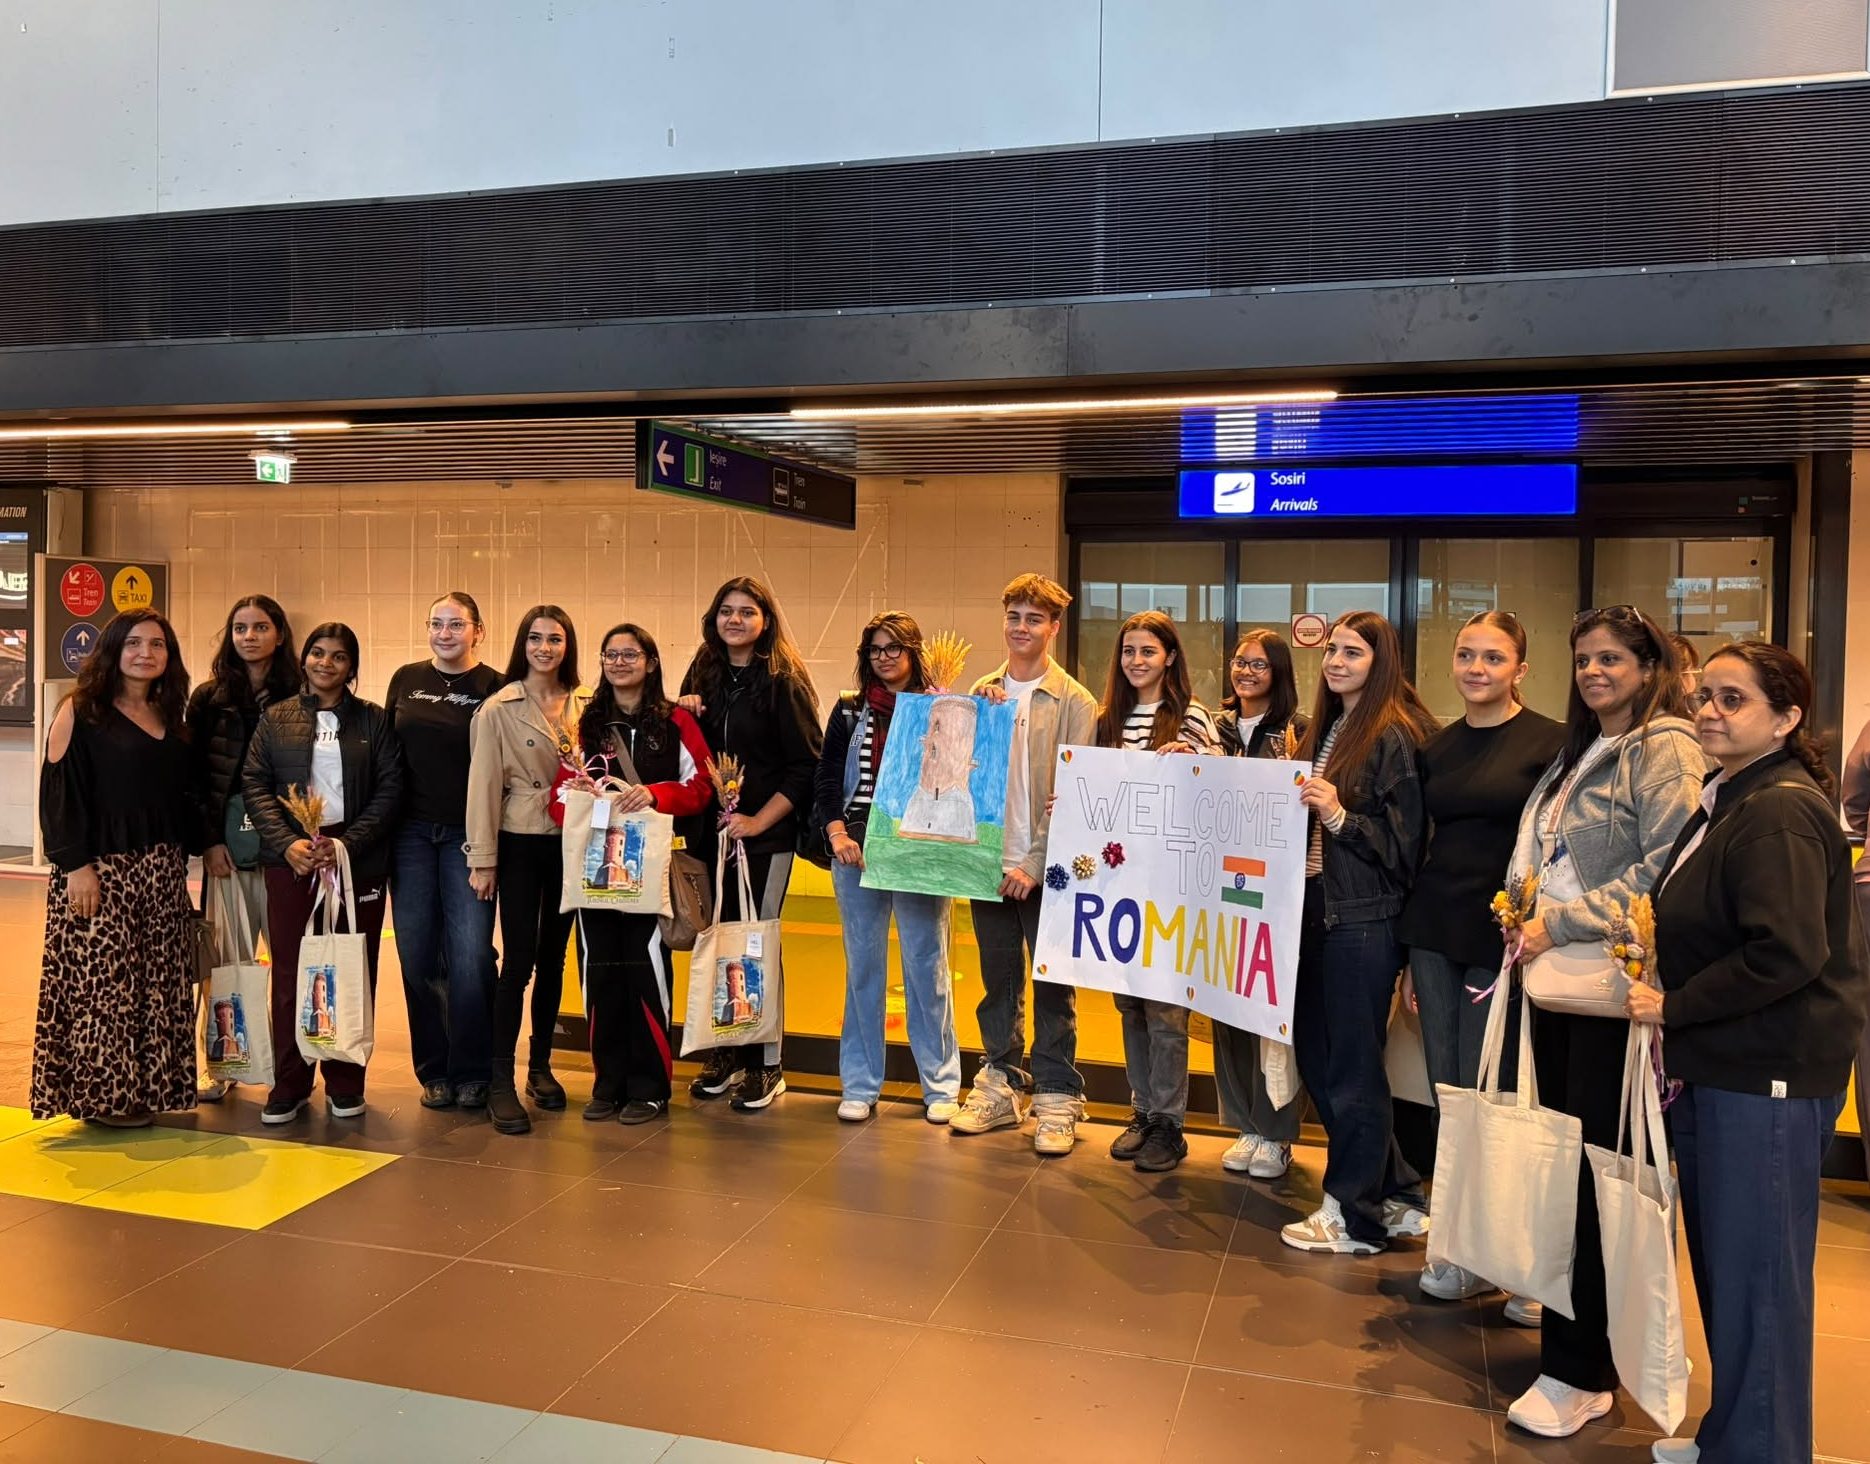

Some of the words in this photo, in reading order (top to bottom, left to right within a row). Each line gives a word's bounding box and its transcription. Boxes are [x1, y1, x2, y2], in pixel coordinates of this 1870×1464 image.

[709, 476, 722, 491] Exit
[1270, 471, 1306, 486] Sosiri
[1270, 497, 1319, 511] Arrivals
[131, 593, 147, 602] TAXI
[409, 689, 442, 703] Tommy
[1076, 776, 1290, 849] WELCOME
[1165, 840, 1217, 897] TO
[1071, 892, 1279, 1007] ROMANIA
